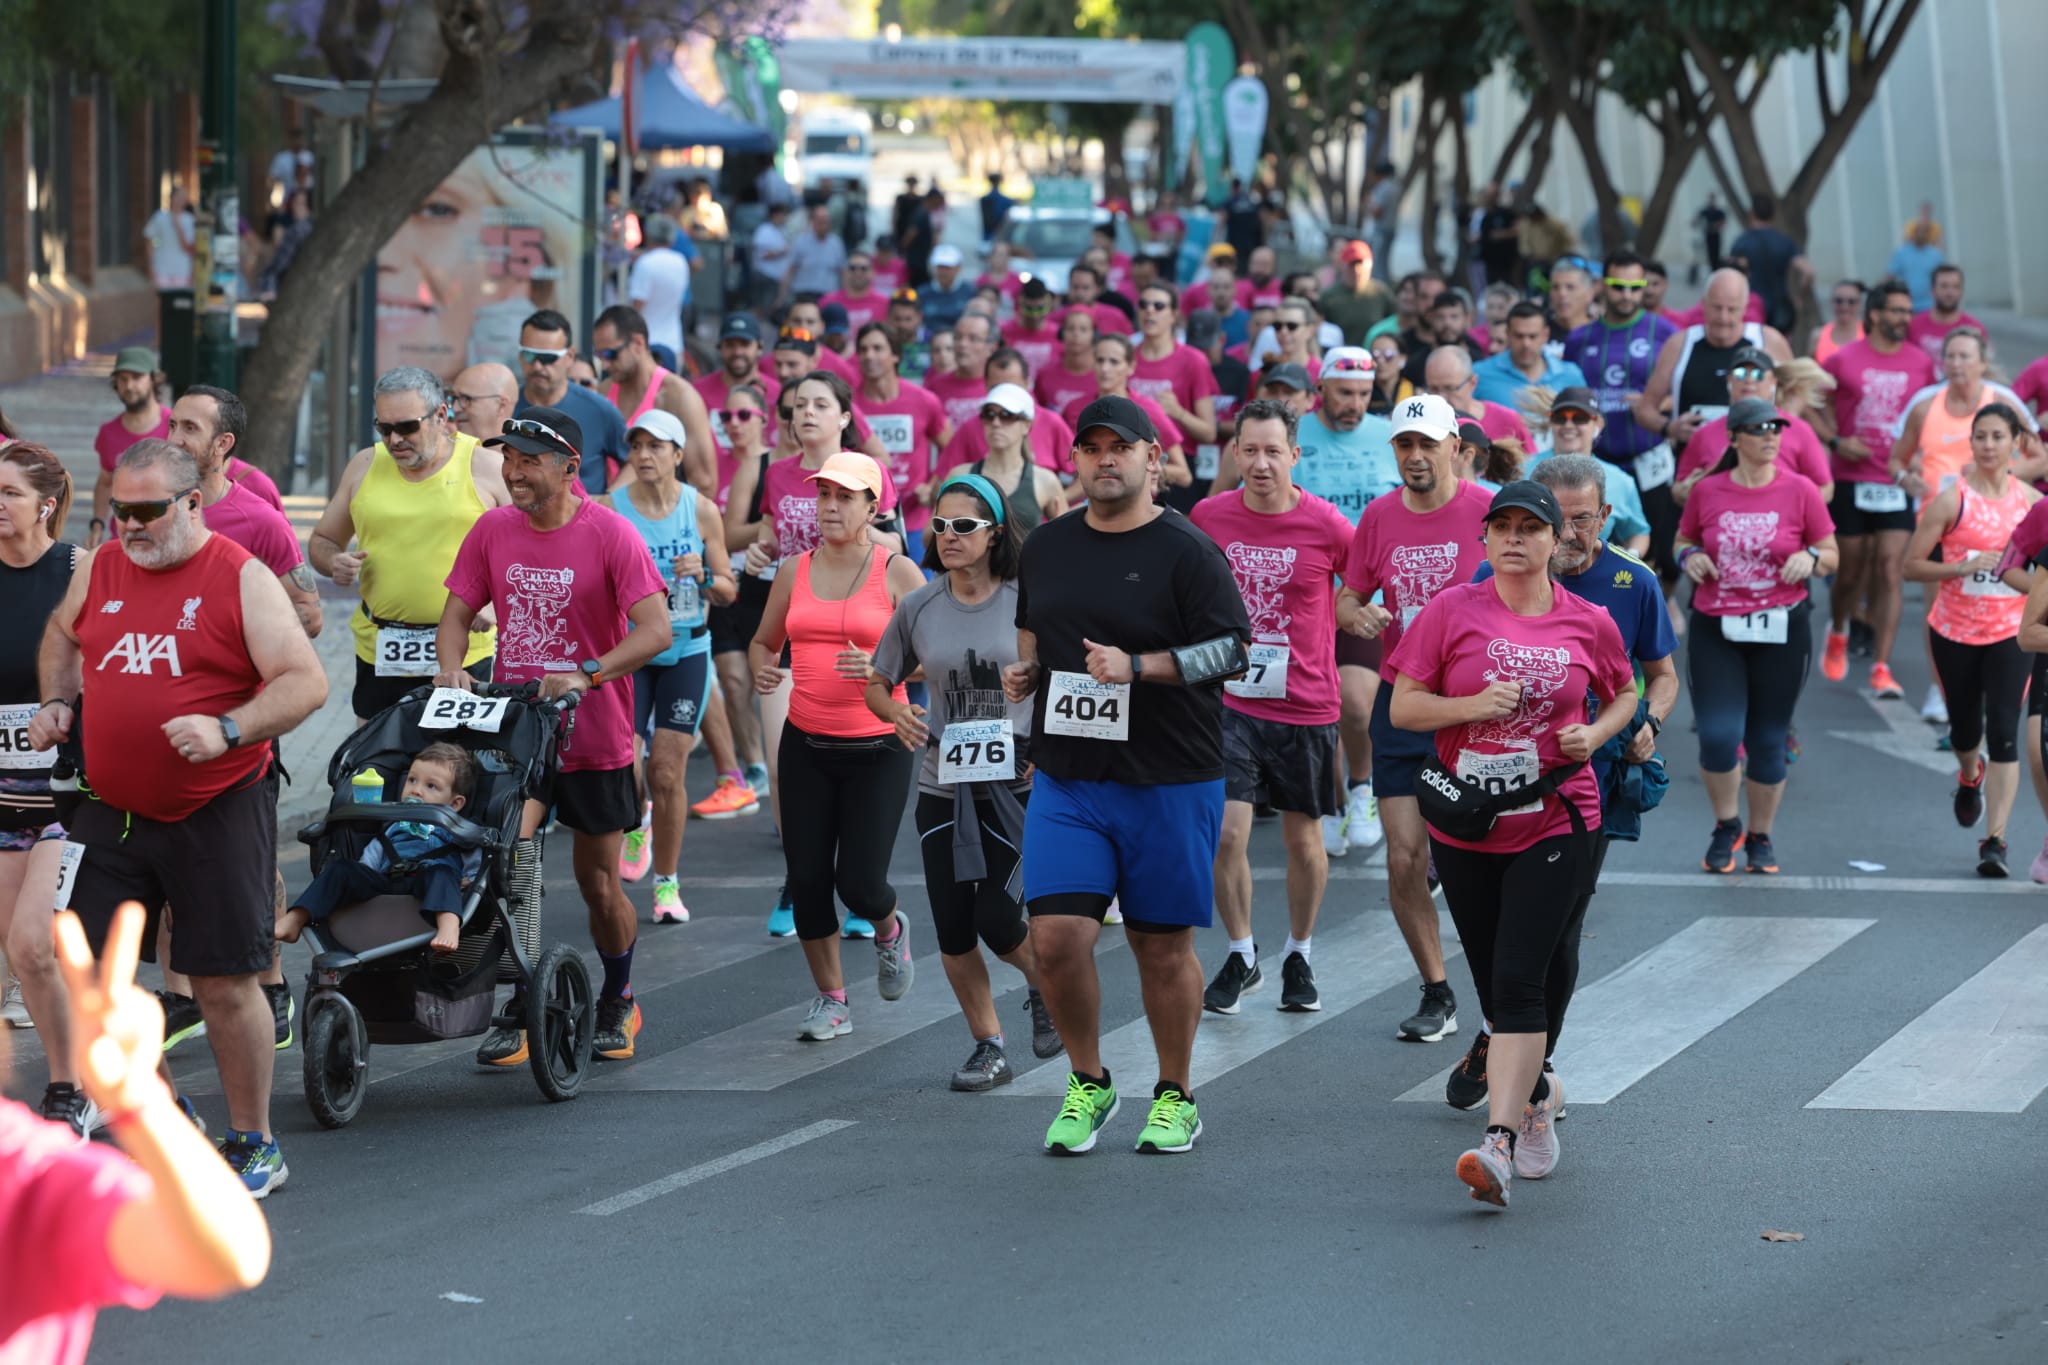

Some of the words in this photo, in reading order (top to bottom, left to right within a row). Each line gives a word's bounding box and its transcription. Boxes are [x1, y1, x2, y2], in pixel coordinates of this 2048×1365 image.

[1406, 402, 1425, 418] NY
[96, 632, 183, 676] AXA
[384, 641, 438, 661] 329
[1492, 641, 1558, 660] Carrera
[968, 690, 1005, 704] TRIATLON
[433, 700, 498, 720] 287
[968, 704, 979, 717] DE
[1055, 695, 1120, 723] 404
[946, 741, 1006, 766] 476
[1420, 768, 1462, 802] adidas
